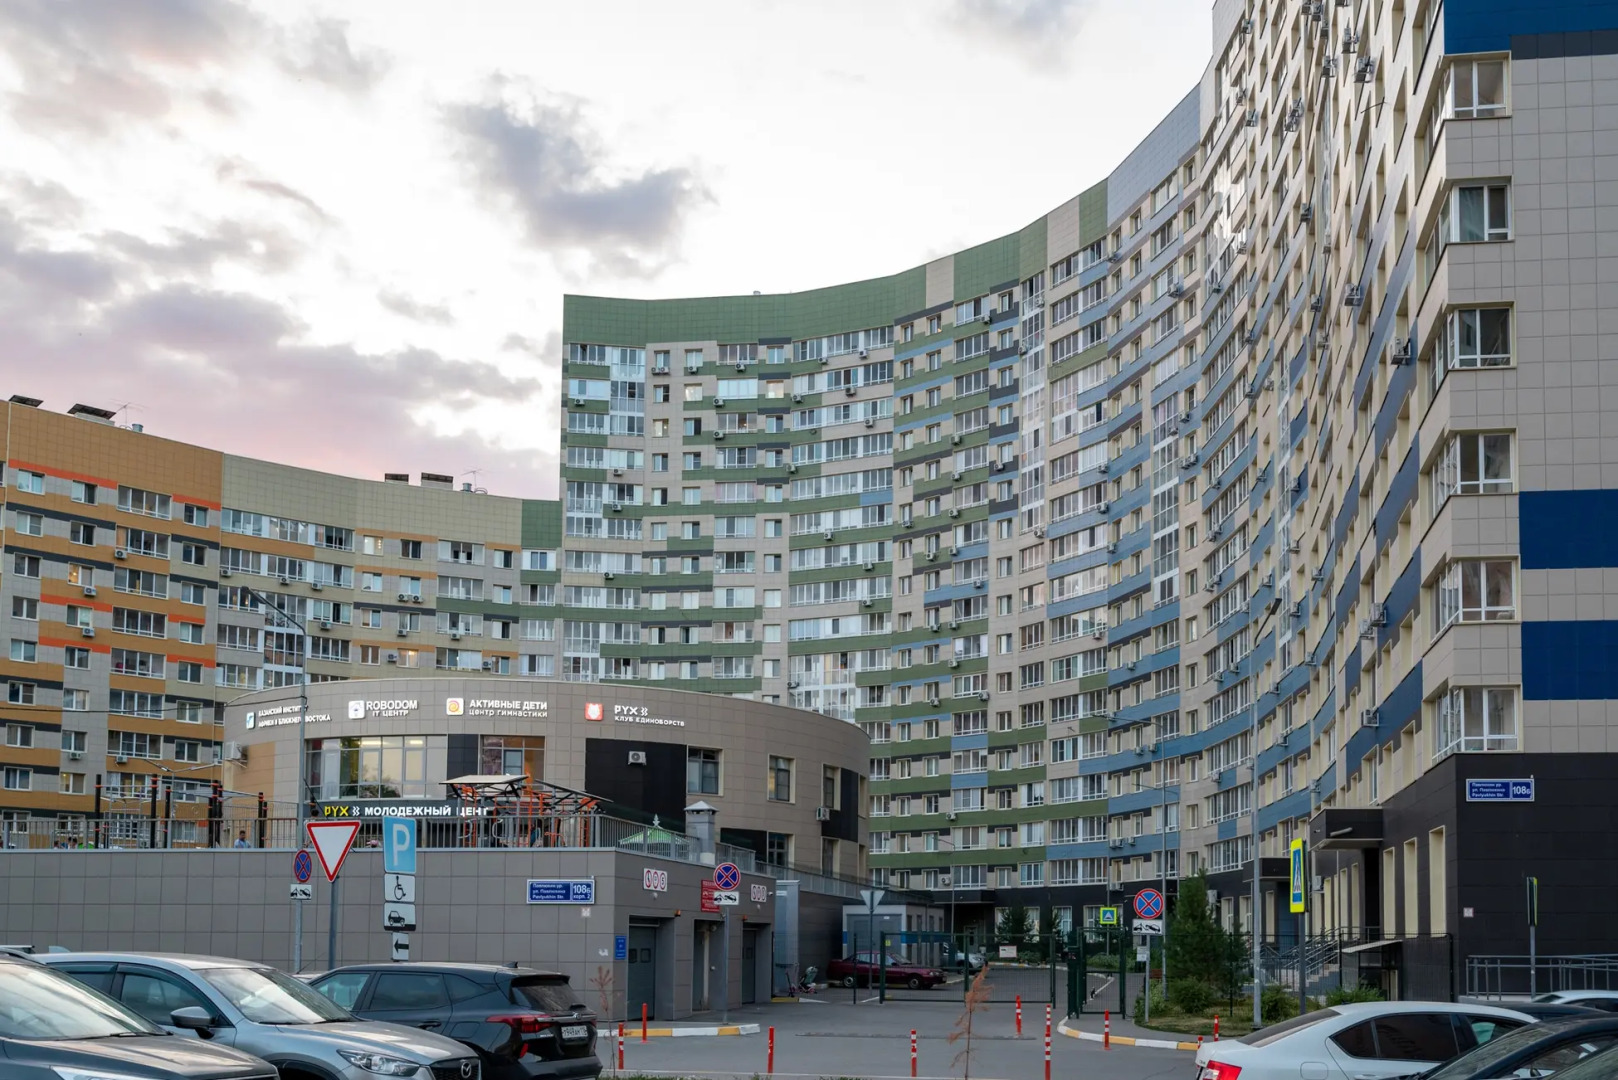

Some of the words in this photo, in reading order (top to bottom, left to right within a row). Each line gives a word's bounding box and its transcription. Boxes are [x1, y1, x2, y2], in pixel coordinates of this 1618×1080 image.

[366, 700, 418, 711] ROBODOM
[469, 699, 521, 709] АКТИВНЫЕ
[522, 701, 548, 711] ДЕТИ
[614, 704, 638, 715] РУХ
[382, 709, 409, 718] ЦЕНТР
[469, 709, 495, 717] центр
[497, 709, 548, 718] гимнастики
[614, 715, 634, 723] КЛУБ
[635, 717, 685, 727] ЕДИНОБОРСТВ
[324, 805, 349, 817] РУХ
[364, 804, 451, 818] МОЛОДЕЖНЫЙ
